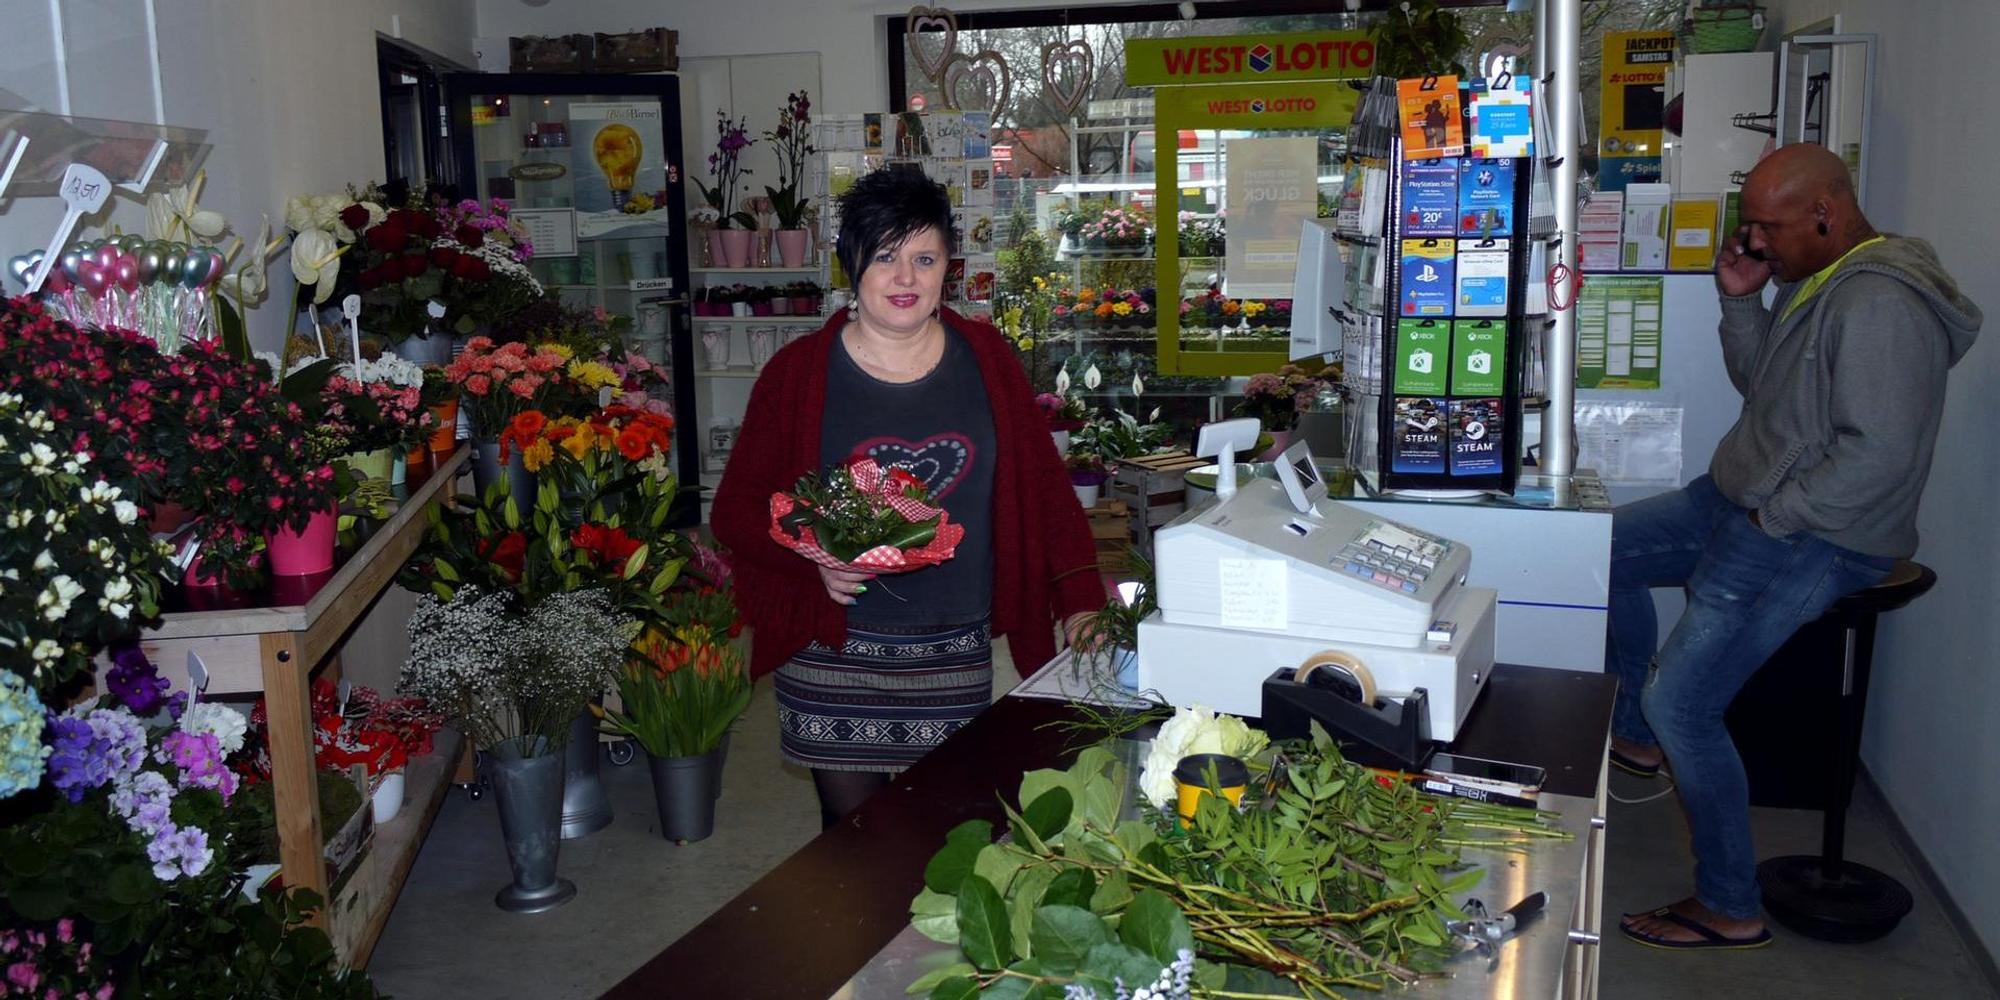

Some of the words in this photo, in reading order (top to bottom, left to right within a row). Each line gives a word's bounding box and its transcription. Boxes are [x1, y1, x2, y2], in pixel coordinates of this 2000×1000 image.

[1625, 37, 1676, 50] JACKPOT
[1164, 47, 1246, 75] WEST
[1277, 42, 1374, 70] LOTTO
[1631, 52, 1668, 63] SAMSTAG
[1622, 73, 1655, 83] LOTTO
[1208, 99, 1249, 114] WEST
[1265, 97, 1317, 113] LOTTO
[1405, 434, 1438, 443] STEAM
[1456, 442, 1493, 453] STEAM
